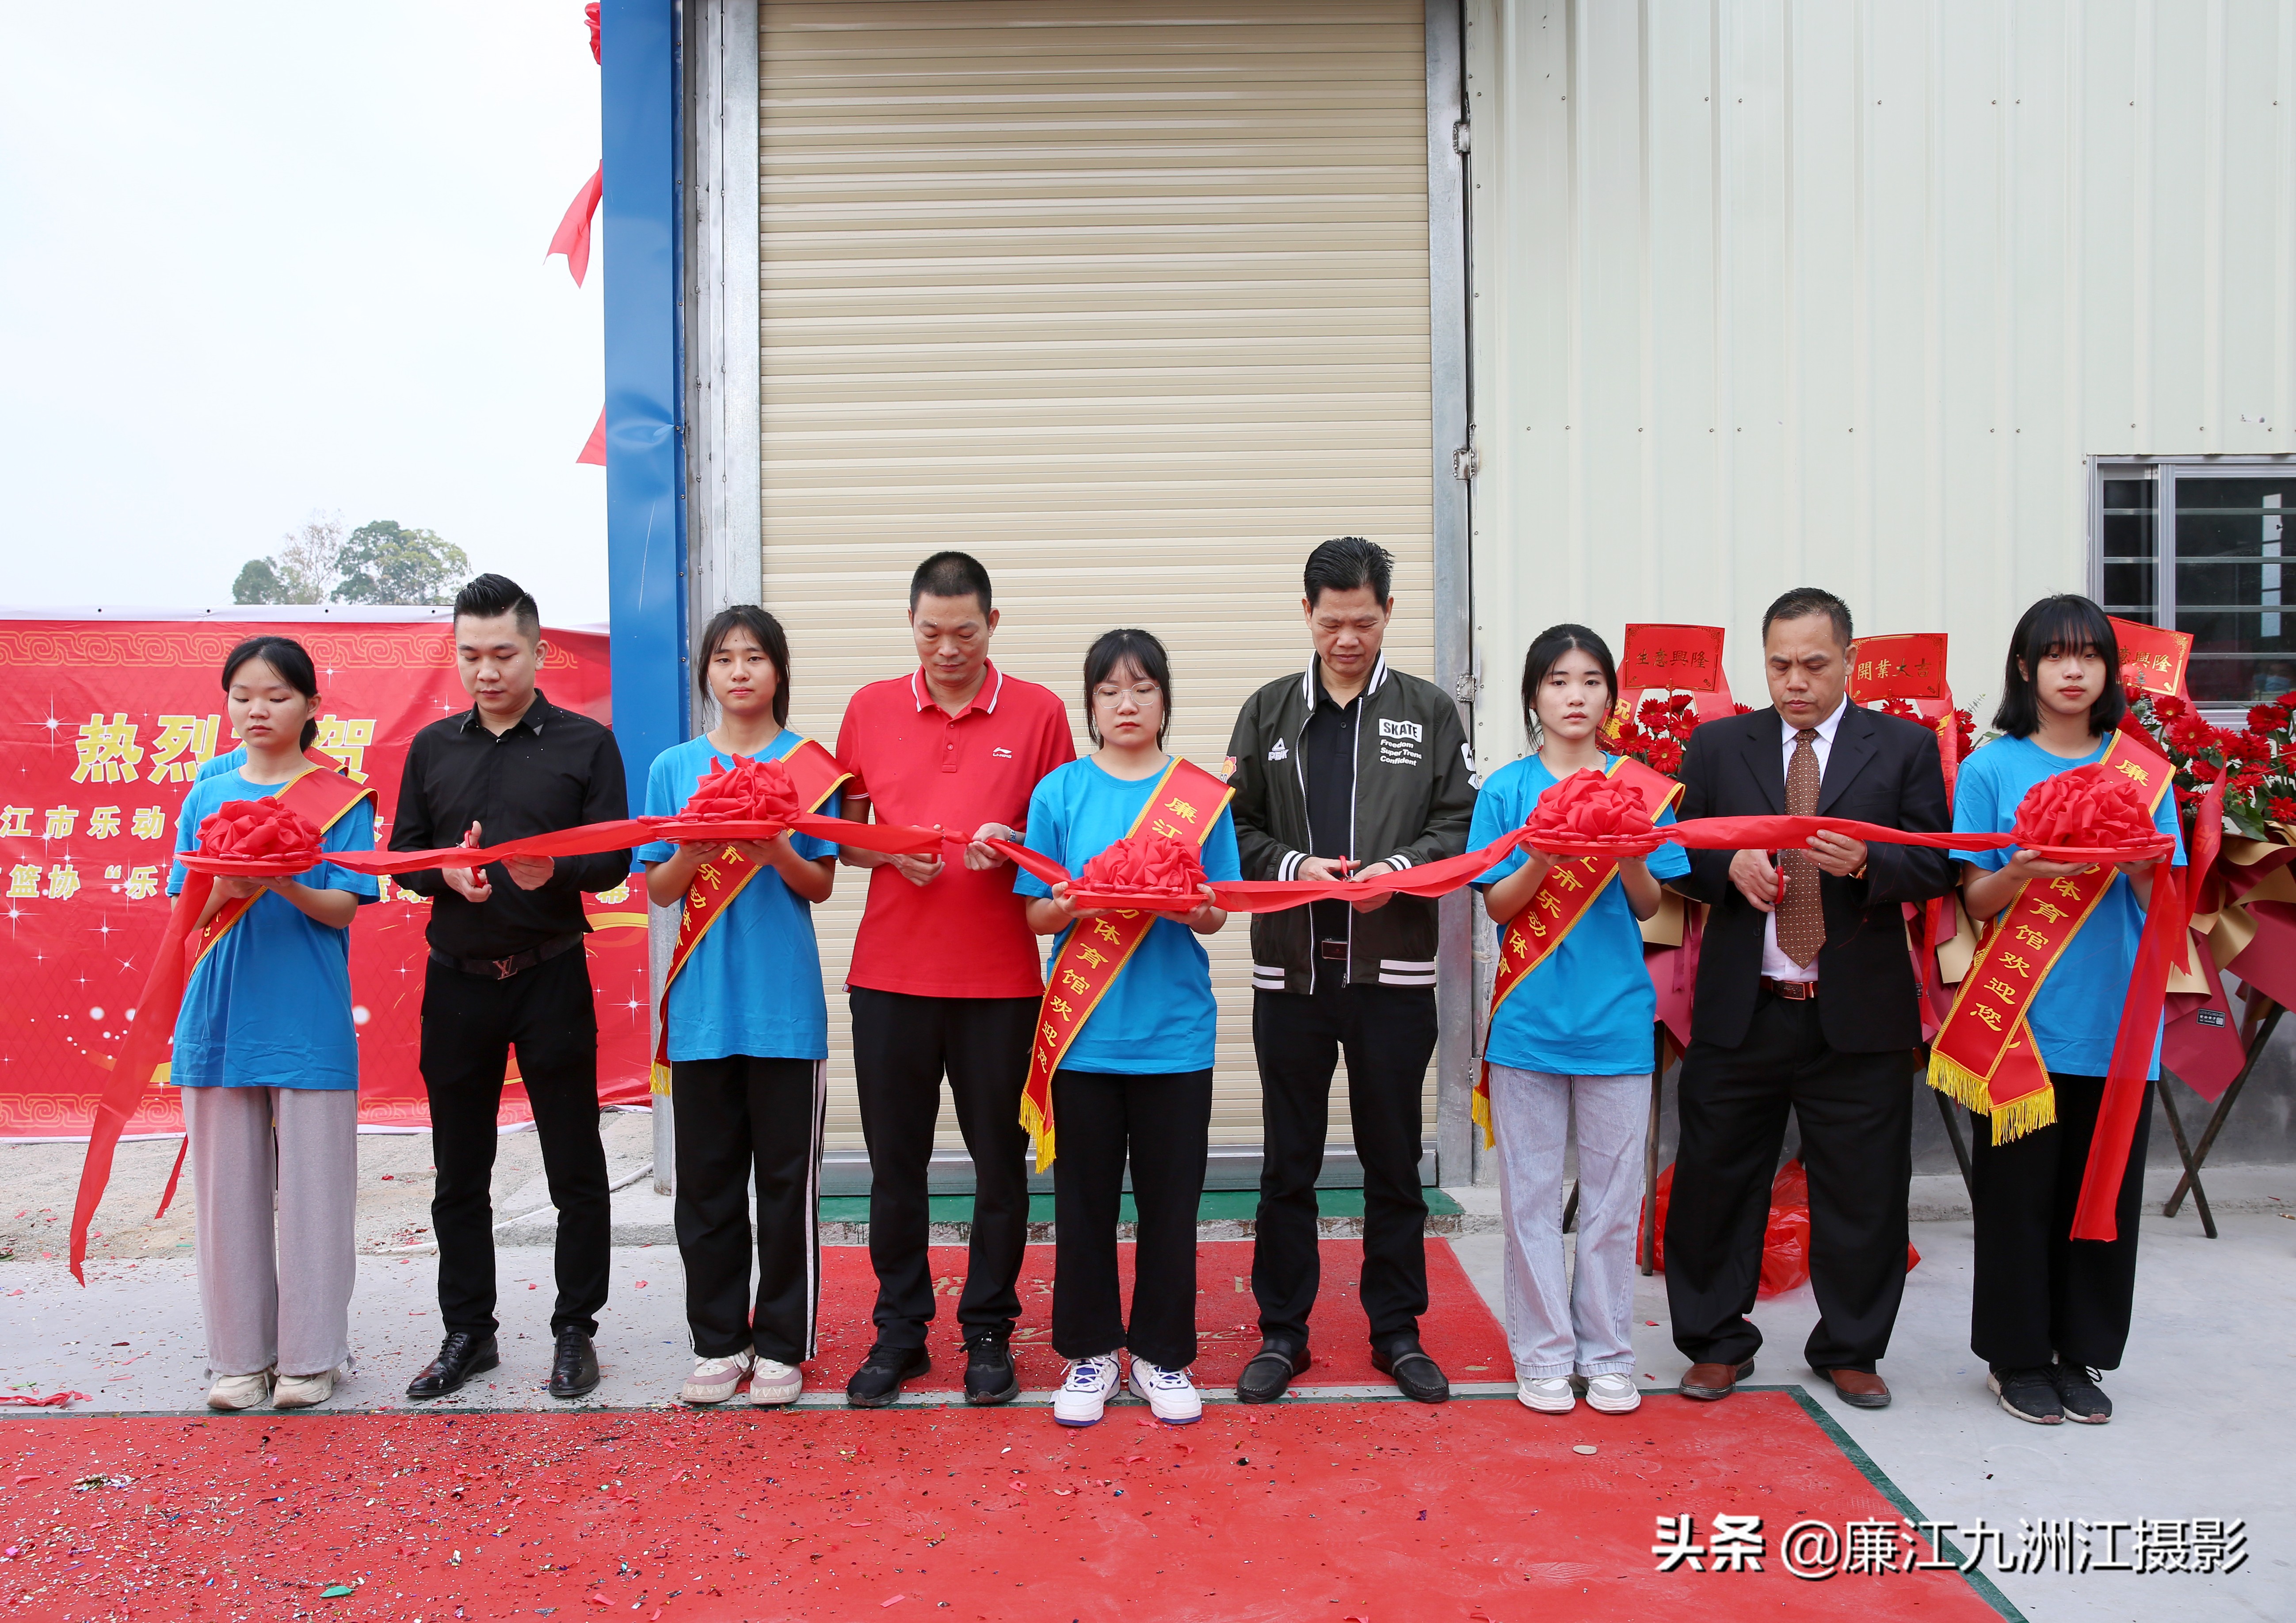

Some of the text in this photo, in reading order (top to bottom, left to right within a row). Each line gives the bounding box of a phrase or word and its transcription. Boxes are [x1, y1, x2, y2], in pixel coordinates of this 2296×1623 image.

[1636, 648, 1709, 668] 生意興隆
[1857, 658, 1931, 680] 開業大吉
[1383, 722, 1417, 738] SKATE
[71, 713, 377, 784] 热烈贺
[1380, 739, 1414, 748] Freedom
[1380, 747, 1403, 756] Super
[1380, 756, 1417, 766] Confident
[0, 805, 179, 840] 江市乐动
[1494, 856, 1598, 996] 市乐动体育
